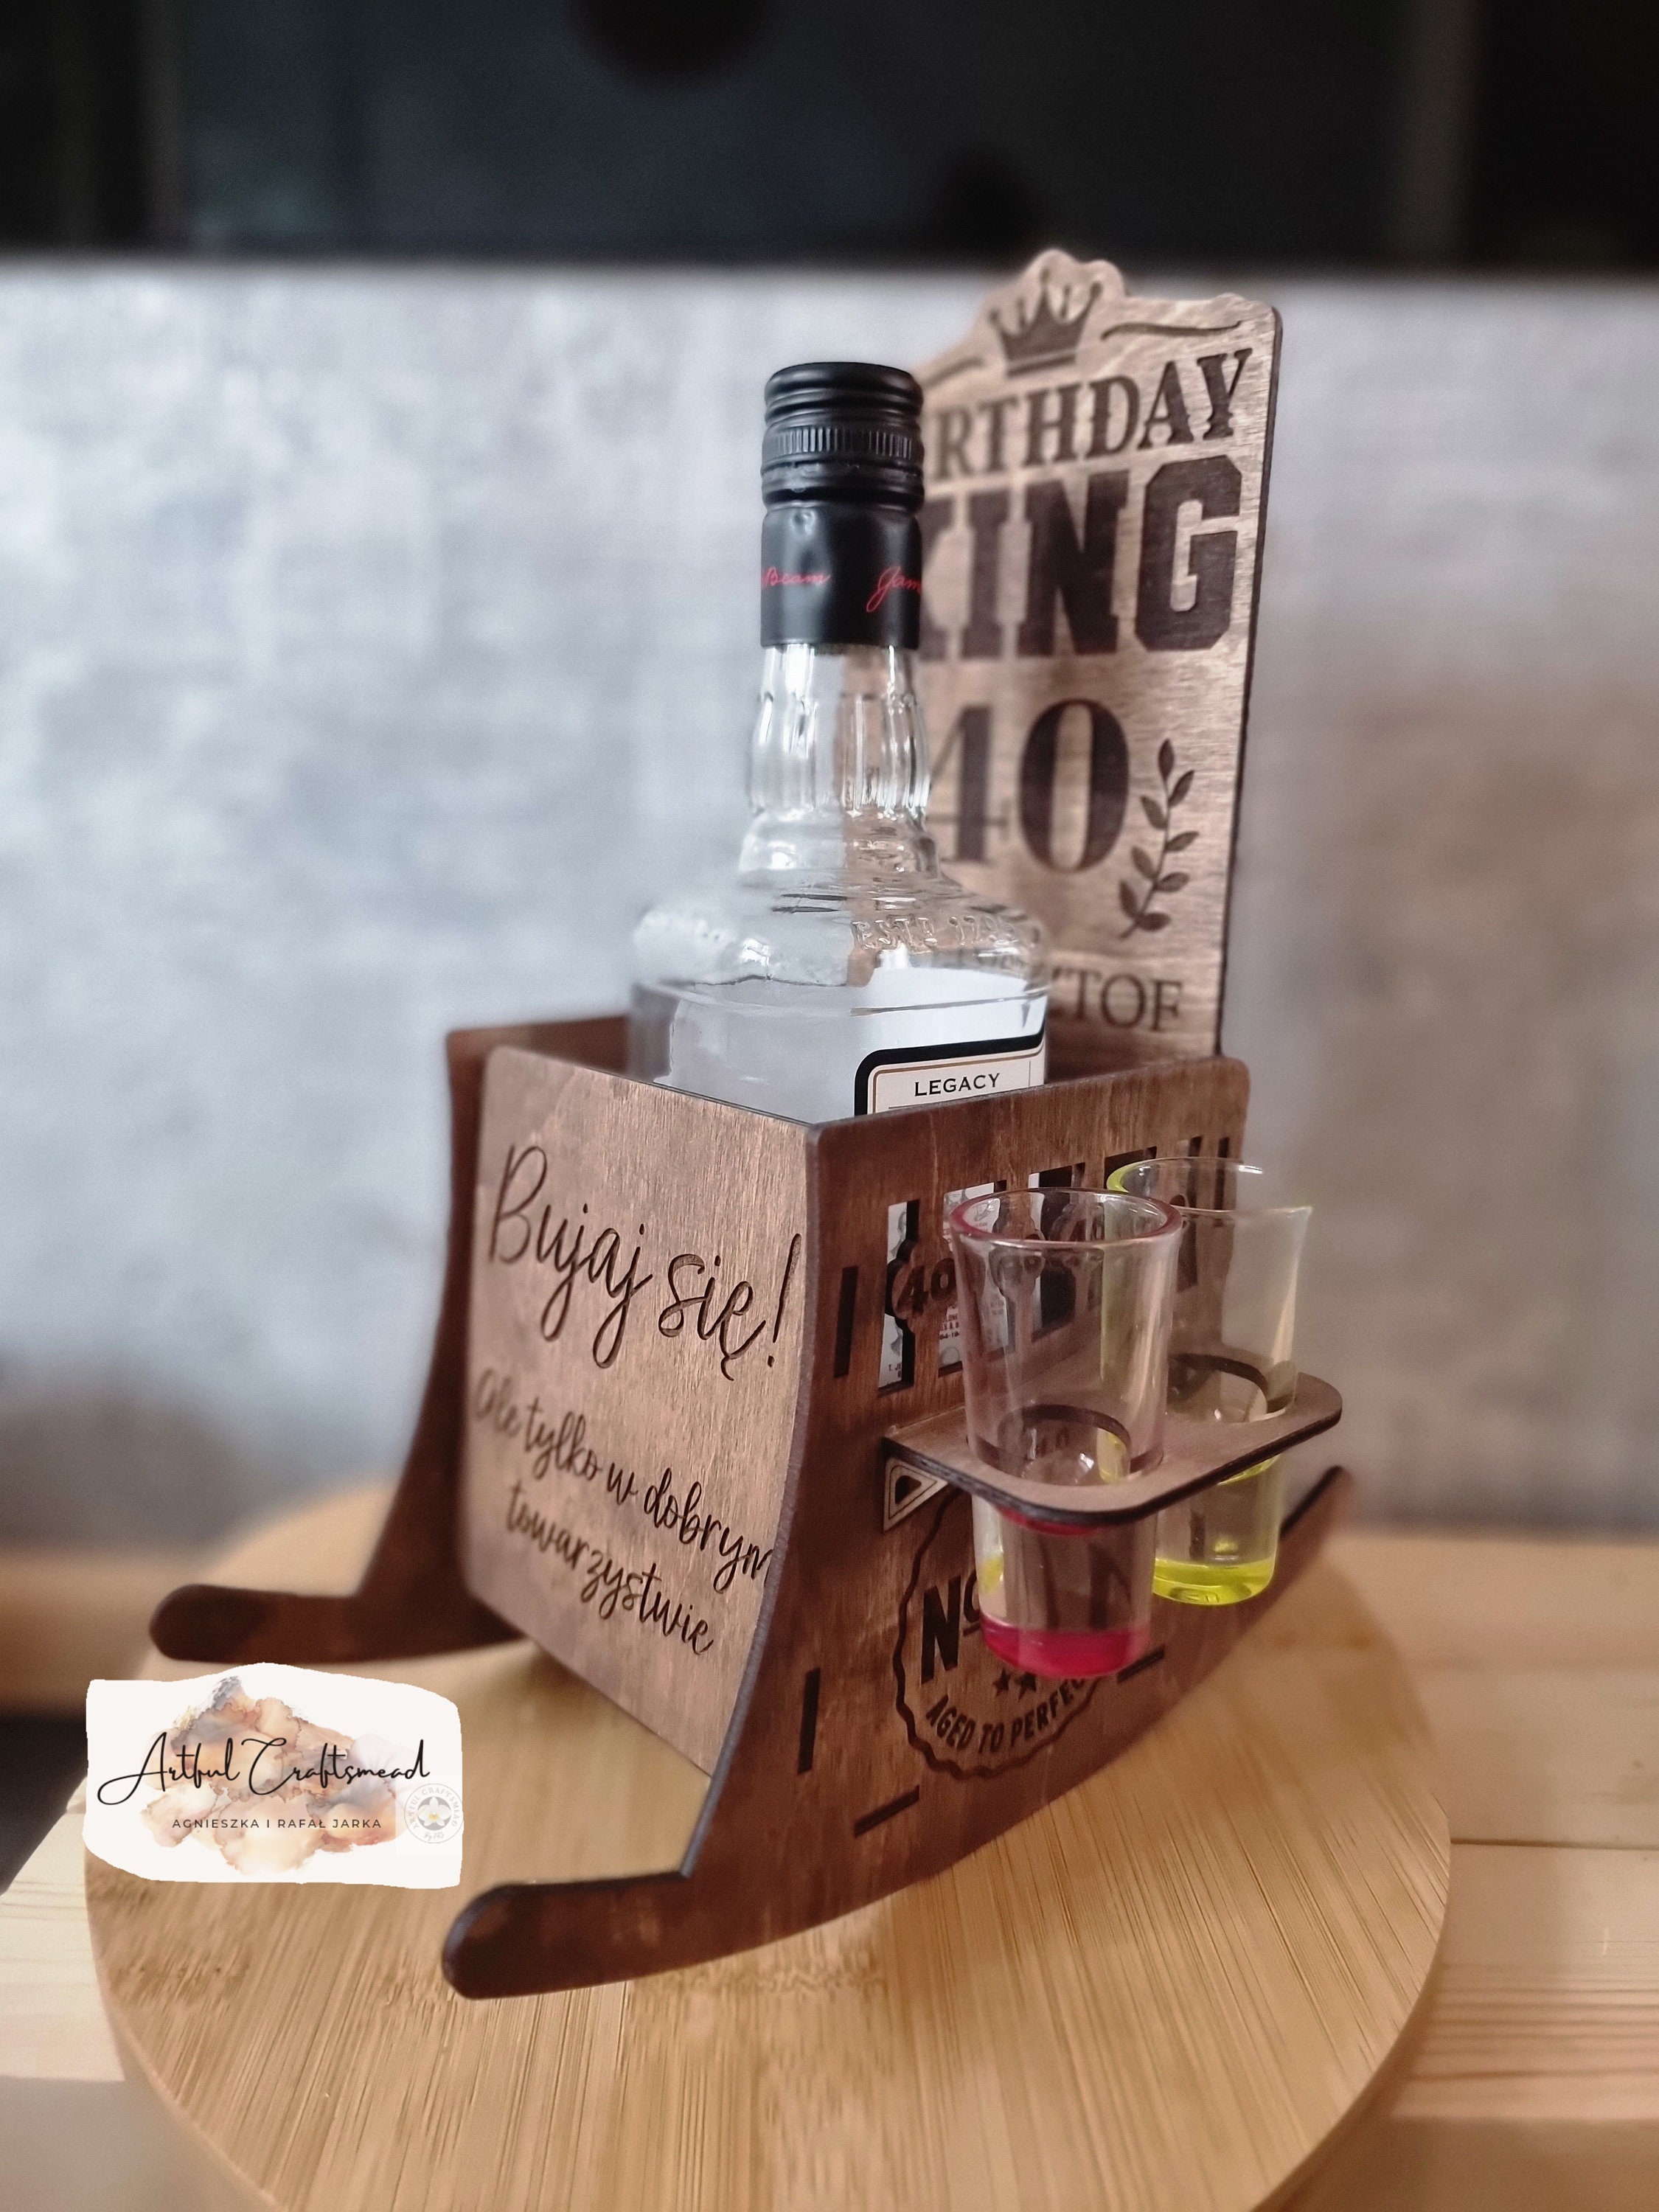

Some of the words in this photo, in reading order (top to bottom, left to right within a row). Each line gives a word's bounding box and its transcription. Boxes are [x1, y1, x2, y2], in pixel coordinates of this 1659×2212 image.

[933, 348, 1252, 479] RTHDAY
[914, 1072, 1001, 1097] LEGACY
[489, 1145, 653, 1369] Bujaj
[658, 1234, 801, 1381] się!
[896, 1258, 956, 1315] 40
[525, 1396, 603, 1481] tylko
[607, 1462, 639, 1505] w
[506, 1479, 714, 1655] towarzystwie
[925, 1694, 976, 1750] AGED
[978, 1722, 1005, 1754] TO
